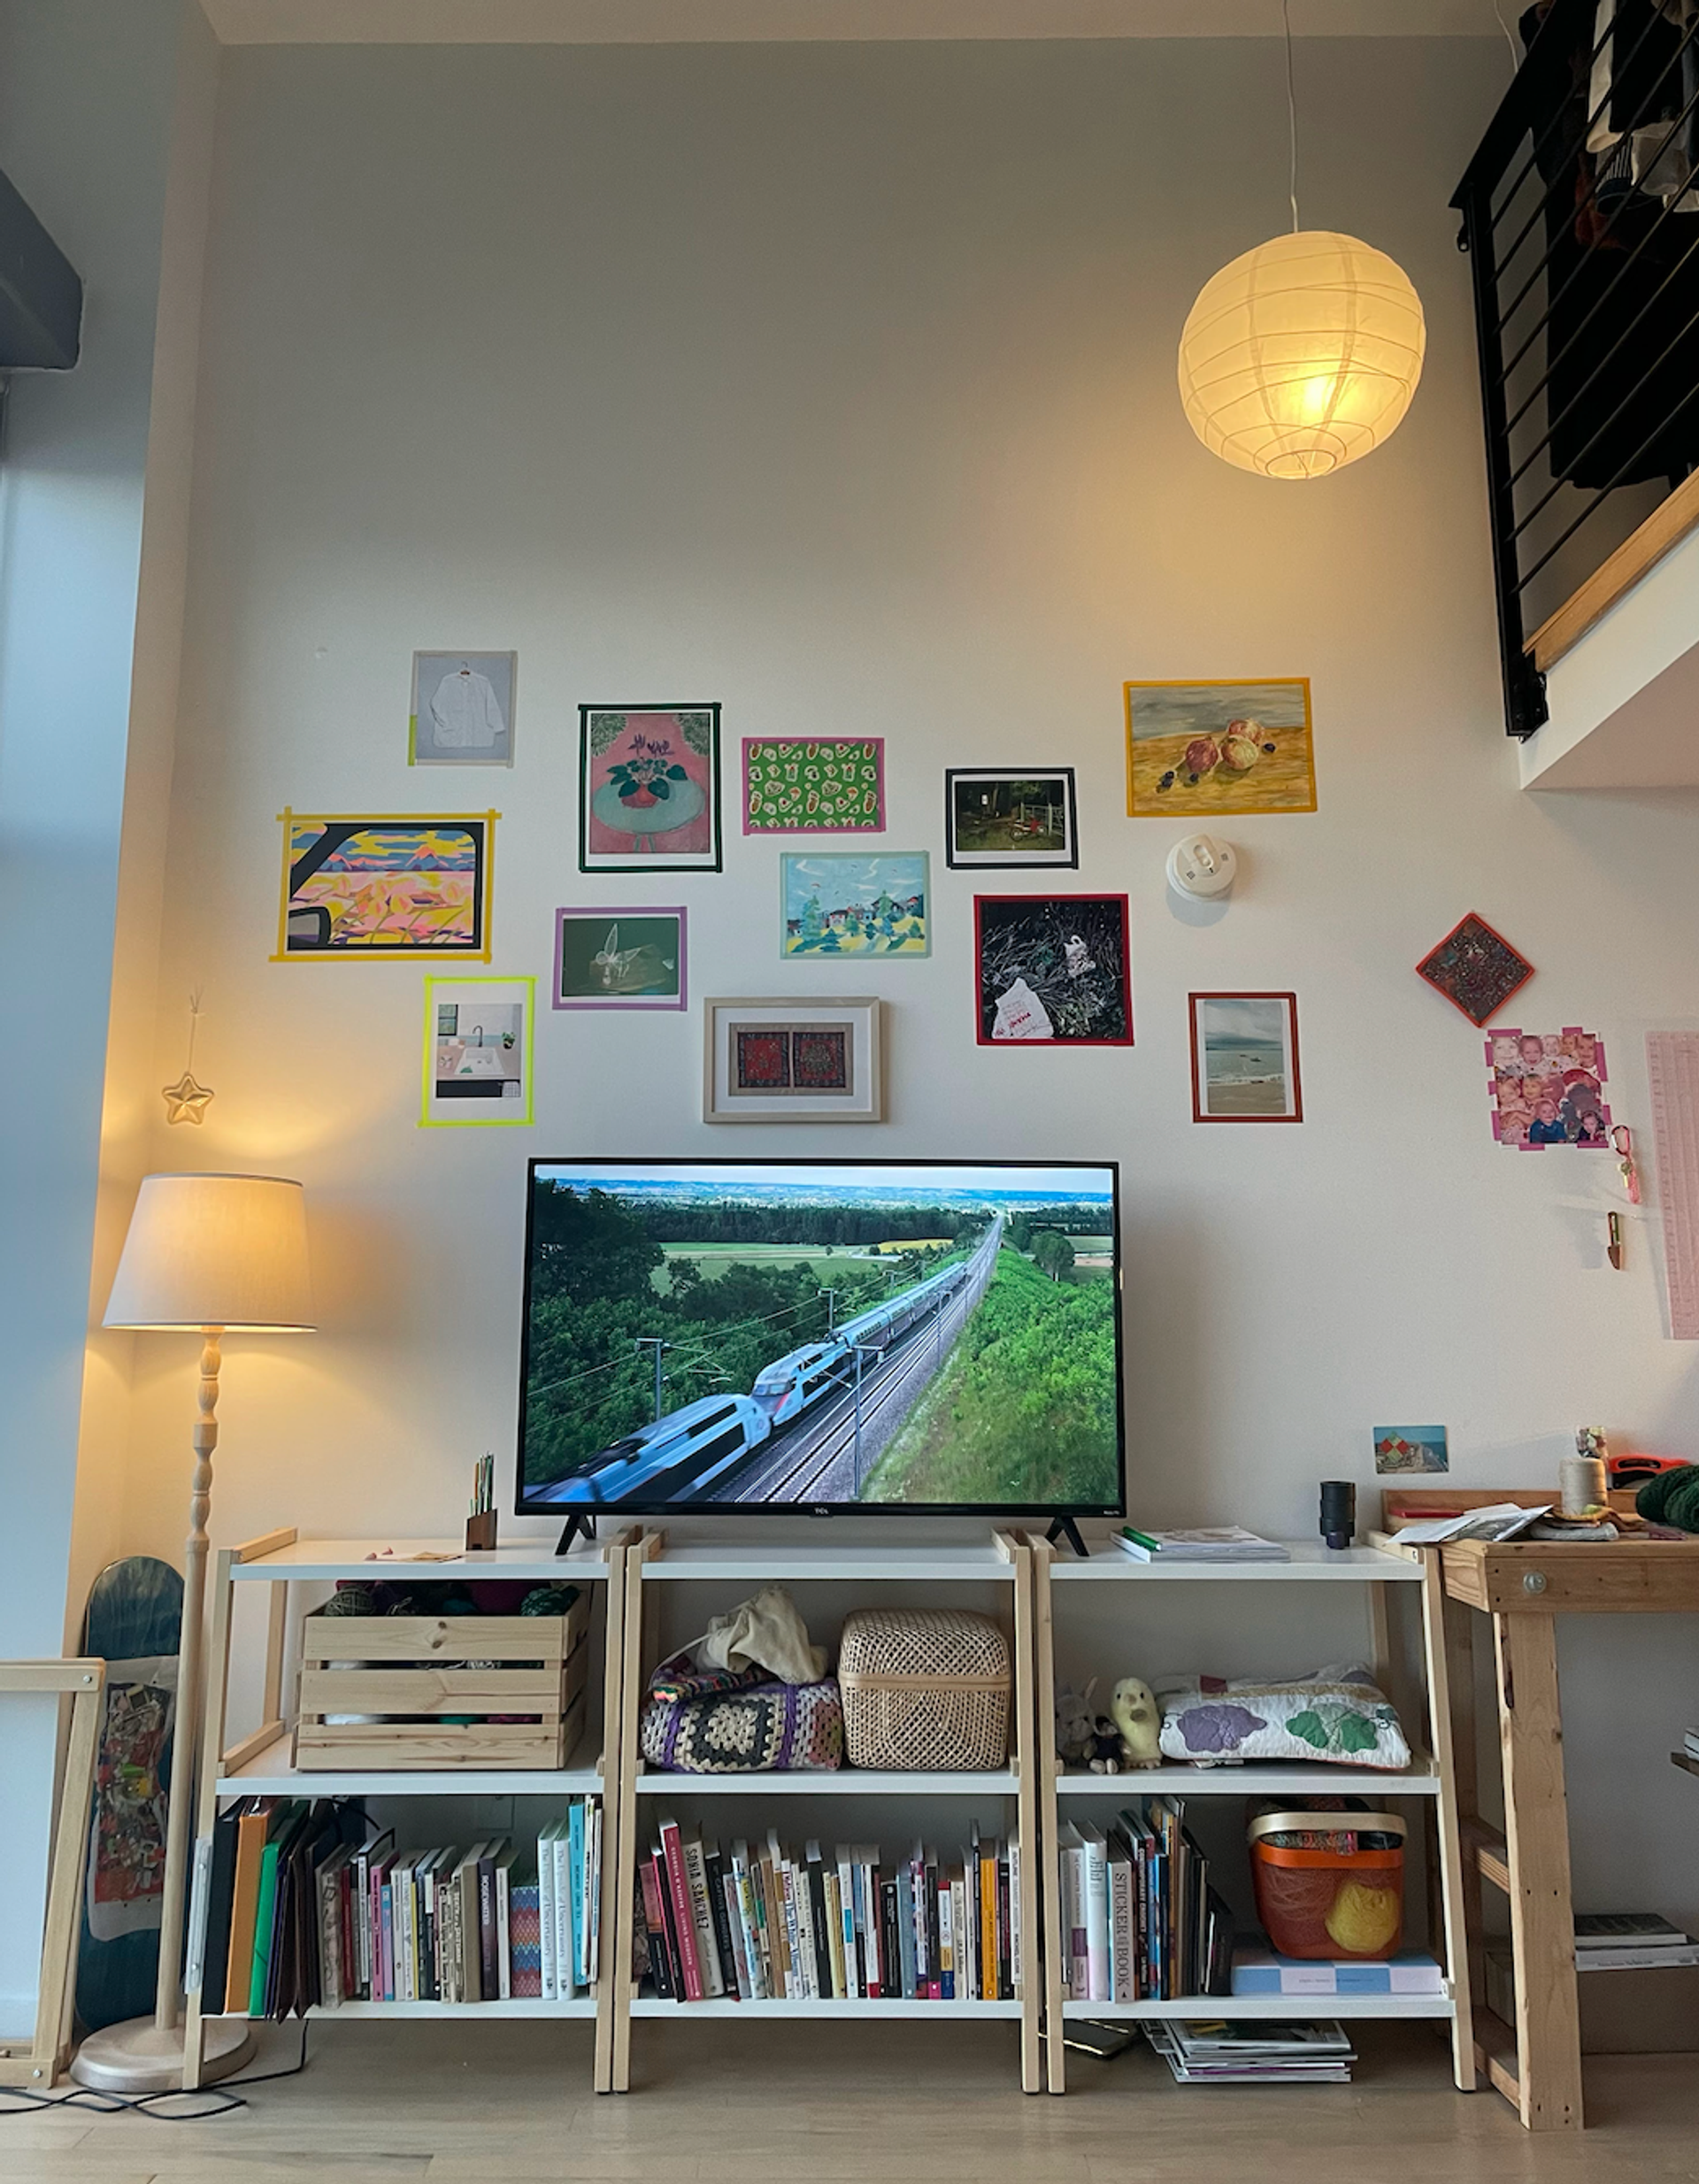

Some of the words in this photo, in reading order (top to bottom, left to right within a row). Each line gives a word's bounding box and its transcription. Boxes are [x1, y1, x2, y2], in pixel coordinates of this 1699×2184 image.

[686, 1848, 699, 1880] SONIA
[481, 1874, 490, 1926] ROSEWATER
[691, 1883, 709, 1929] SANCHEZ
[1114, 1873, 1128, 1934] STICKER
[542, 1903, 554, 1957] Uncertainty
[557, 1904, 569, 1958] Uncertainty
[1117, 1948, 1130, 1987] BOOK
